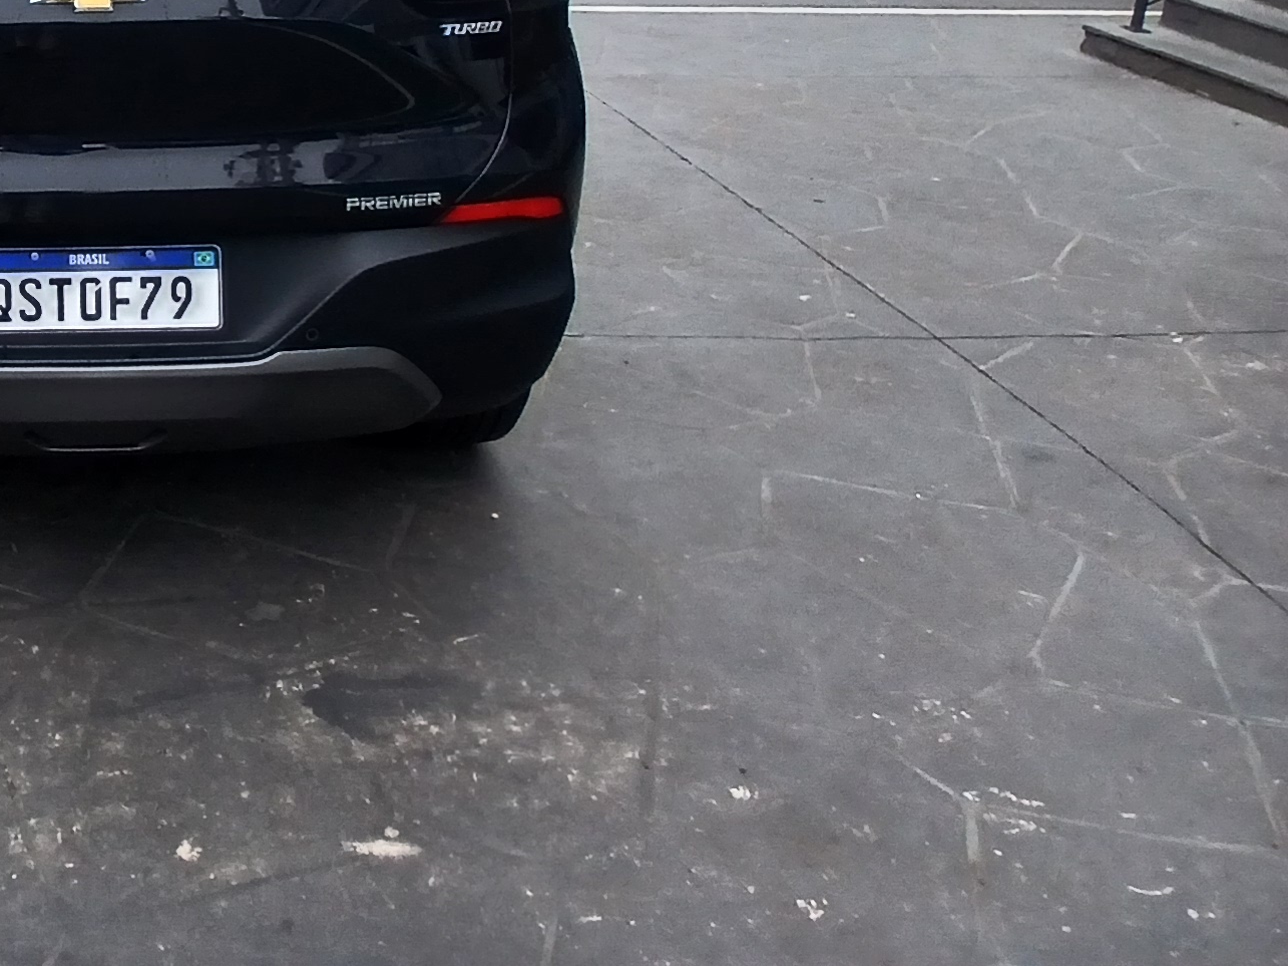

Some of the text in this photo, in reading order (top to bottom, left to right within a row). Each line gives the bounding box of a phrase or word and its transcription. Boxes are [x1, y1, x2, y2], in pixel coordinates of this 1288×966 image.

[439, 21, 503, 35] TURBO
[346, 192, 442, 211] PREMIER
[68, 254, 110, 265] BRASIL
